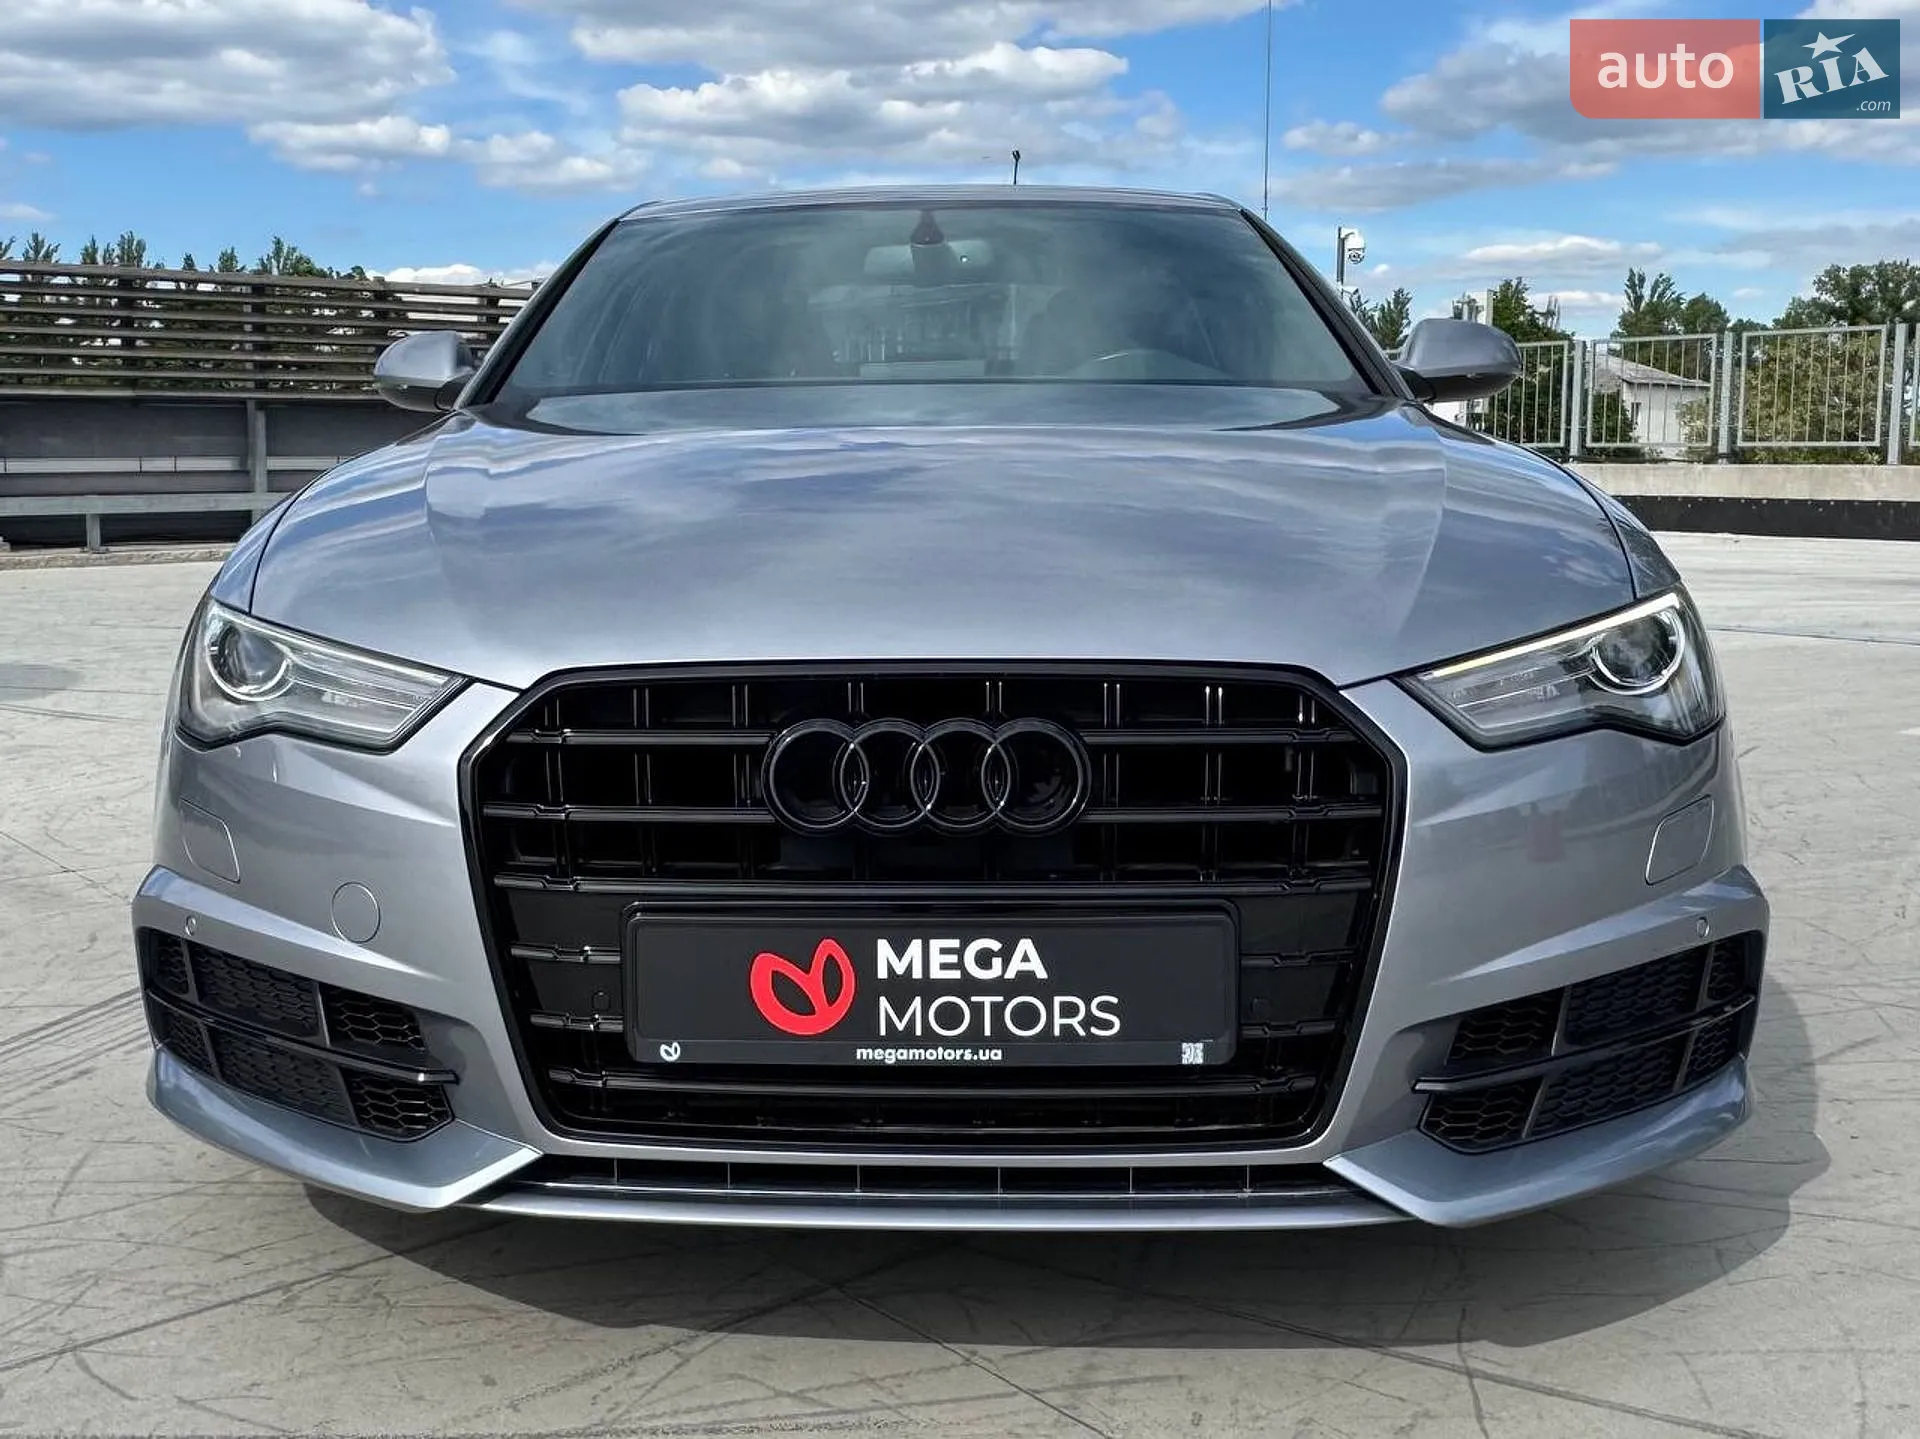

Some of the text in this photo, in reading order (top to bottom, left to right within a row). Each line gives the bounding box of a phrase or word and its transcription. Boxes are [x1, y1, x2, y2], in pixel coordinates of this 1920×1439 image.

[876, 938, 1048, 980] MEGA
[878, 995, 1121, 1037] MOTORS
[855, 1045, 1003, 1065] megamotors.ua
